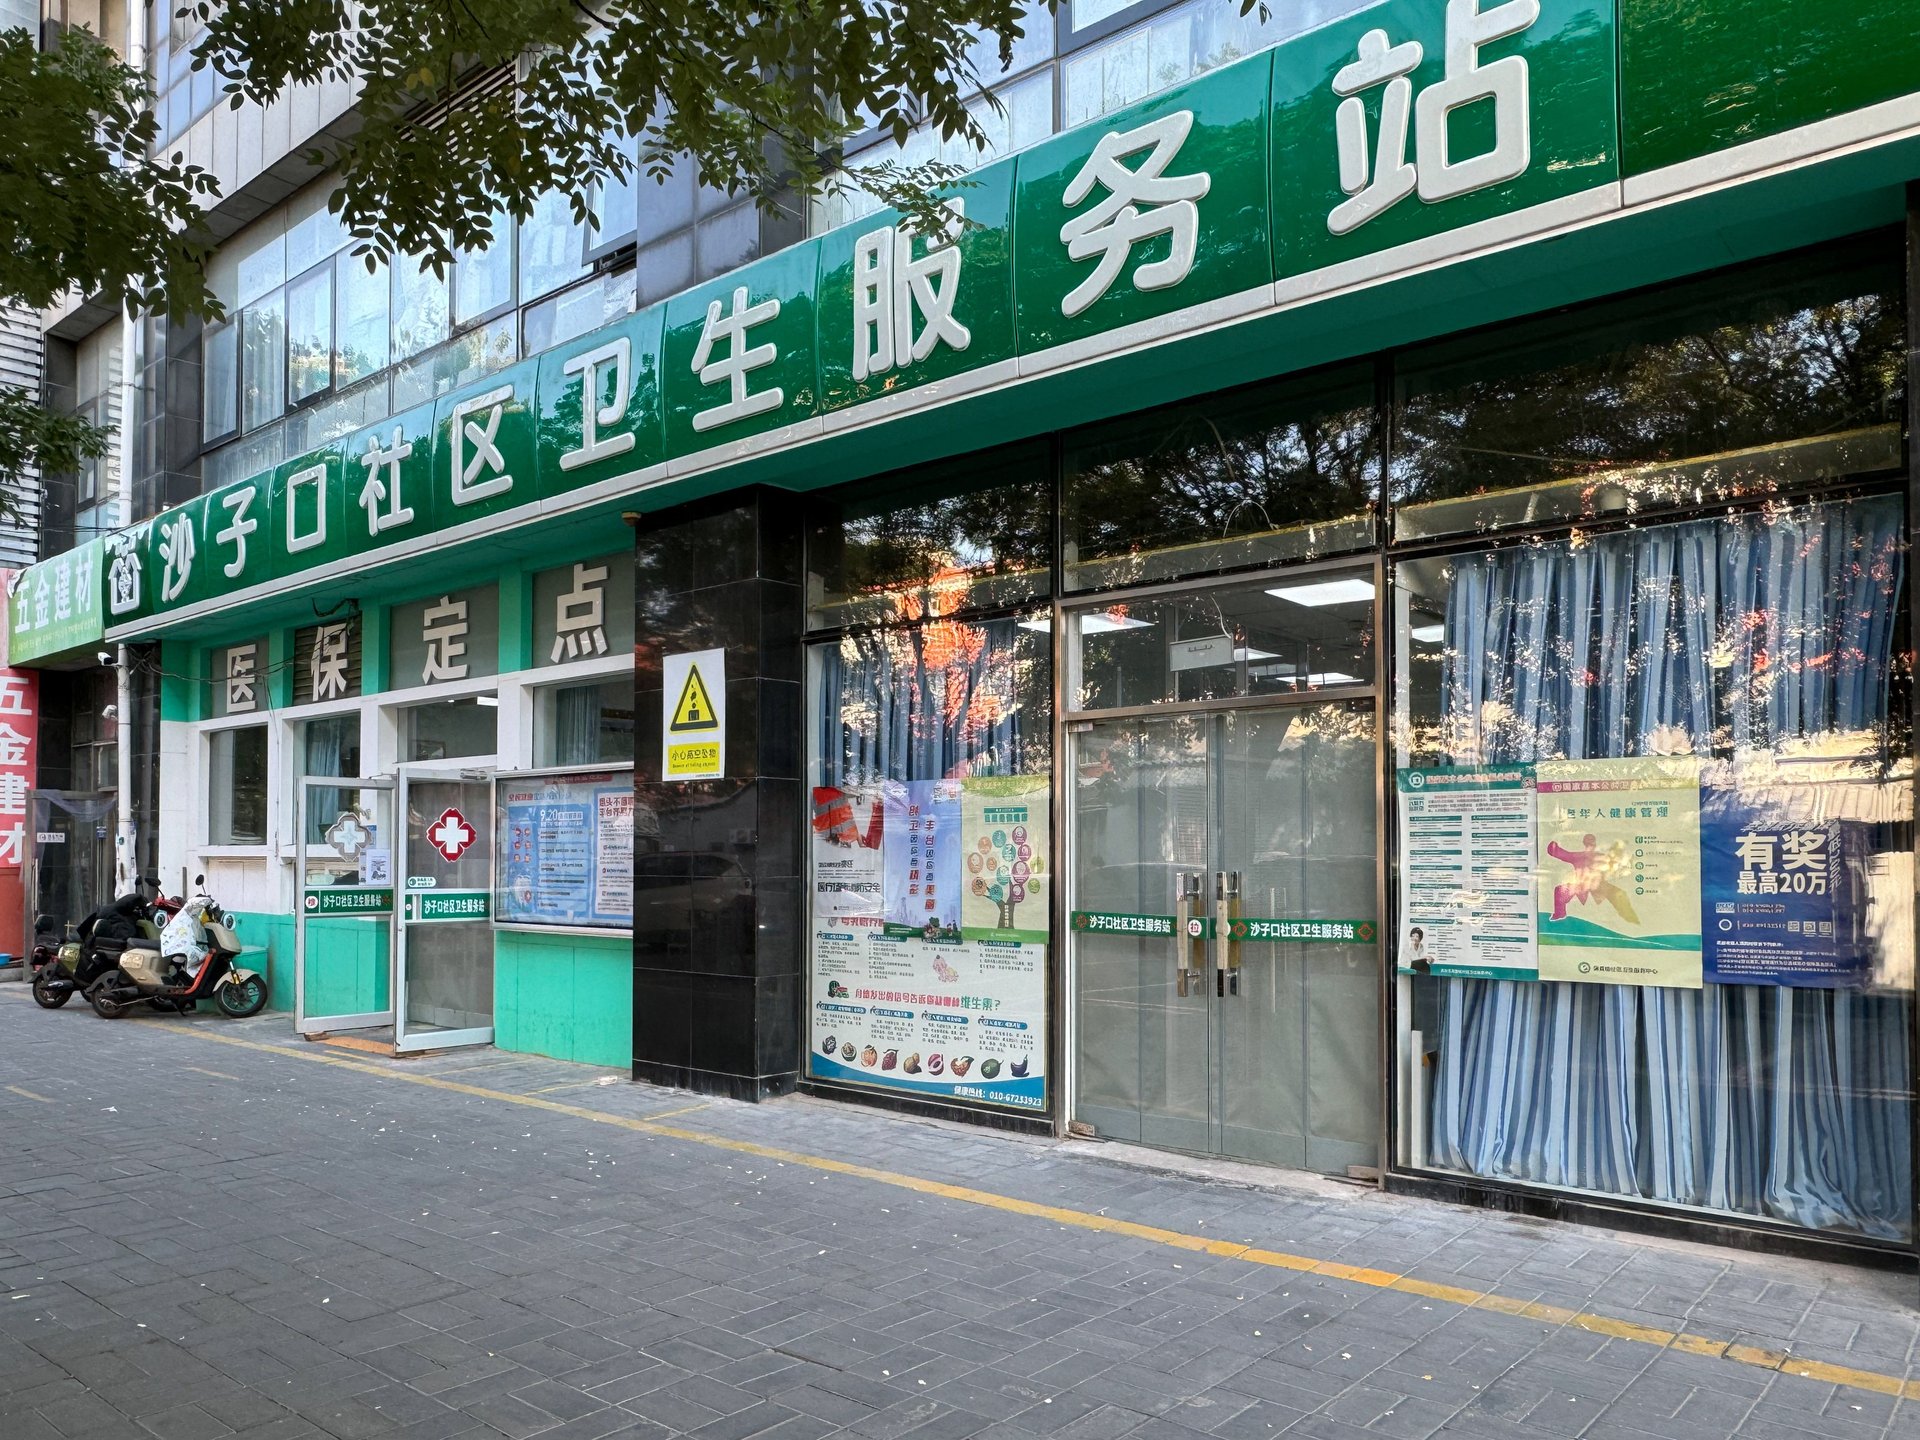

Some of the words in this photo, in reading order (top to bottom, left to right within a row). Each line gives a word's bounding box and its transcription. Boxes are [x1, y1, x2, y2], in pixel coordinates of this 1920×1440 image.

[159, 0, 1540, 603] 沙子口社区卫生服务站
[14, 549, 94, 634] 五金建材
[226, 563, 608, 714] 医保定点
[1735, 831, 1827, 870] 有奖
[1737, 871, 1828, 895] 最高20万
[323, 895, 382, 908] 沙子口社区卫生服务站
[424, 898, 485, 914] 沙子口社区卫生服务站
[1089, 915, 1171, 933] 沙子口社区卫生服务站
[1250, 922, 1354, 940] 沙子口社区卫生服务站
